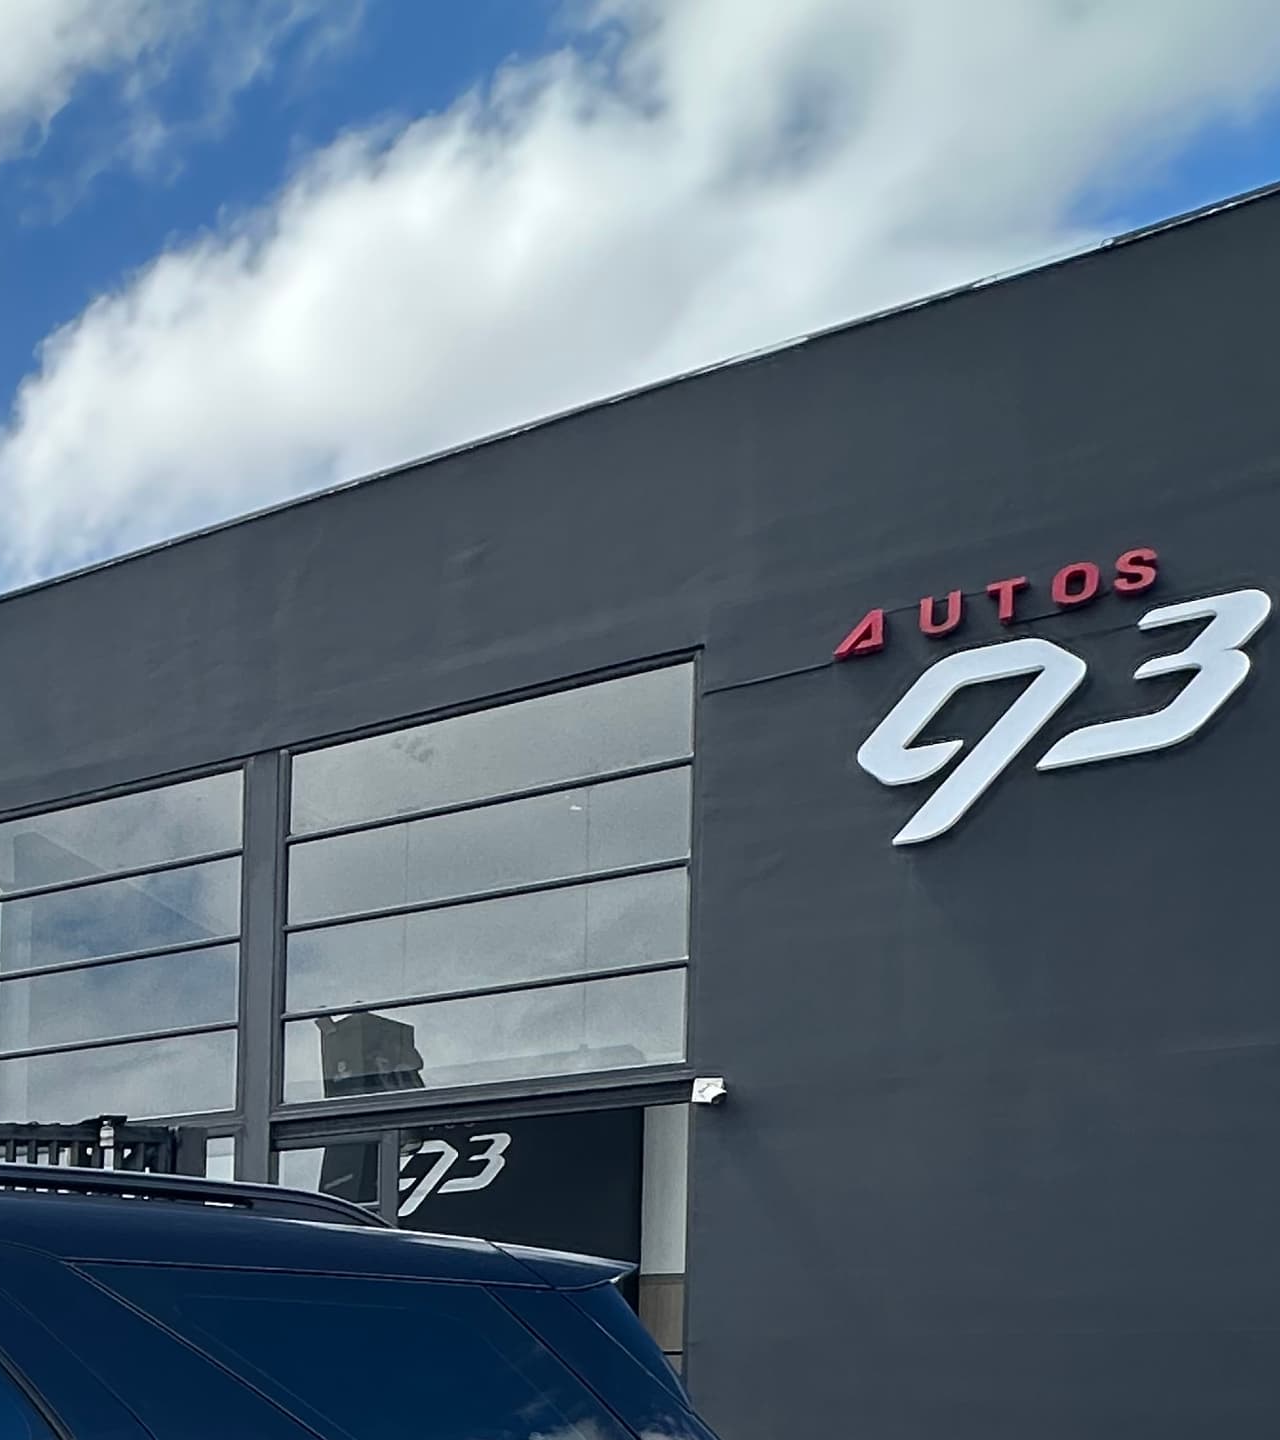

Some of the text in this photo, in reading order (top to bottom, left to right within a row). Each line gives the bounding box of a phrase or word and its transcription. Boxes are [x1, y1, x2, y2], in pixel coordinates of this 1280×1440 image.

[833, 547, 1158, 661] AUTOS
[857, 588, 1271, 846] 93
[397, 1131, 512, 1218] 93
